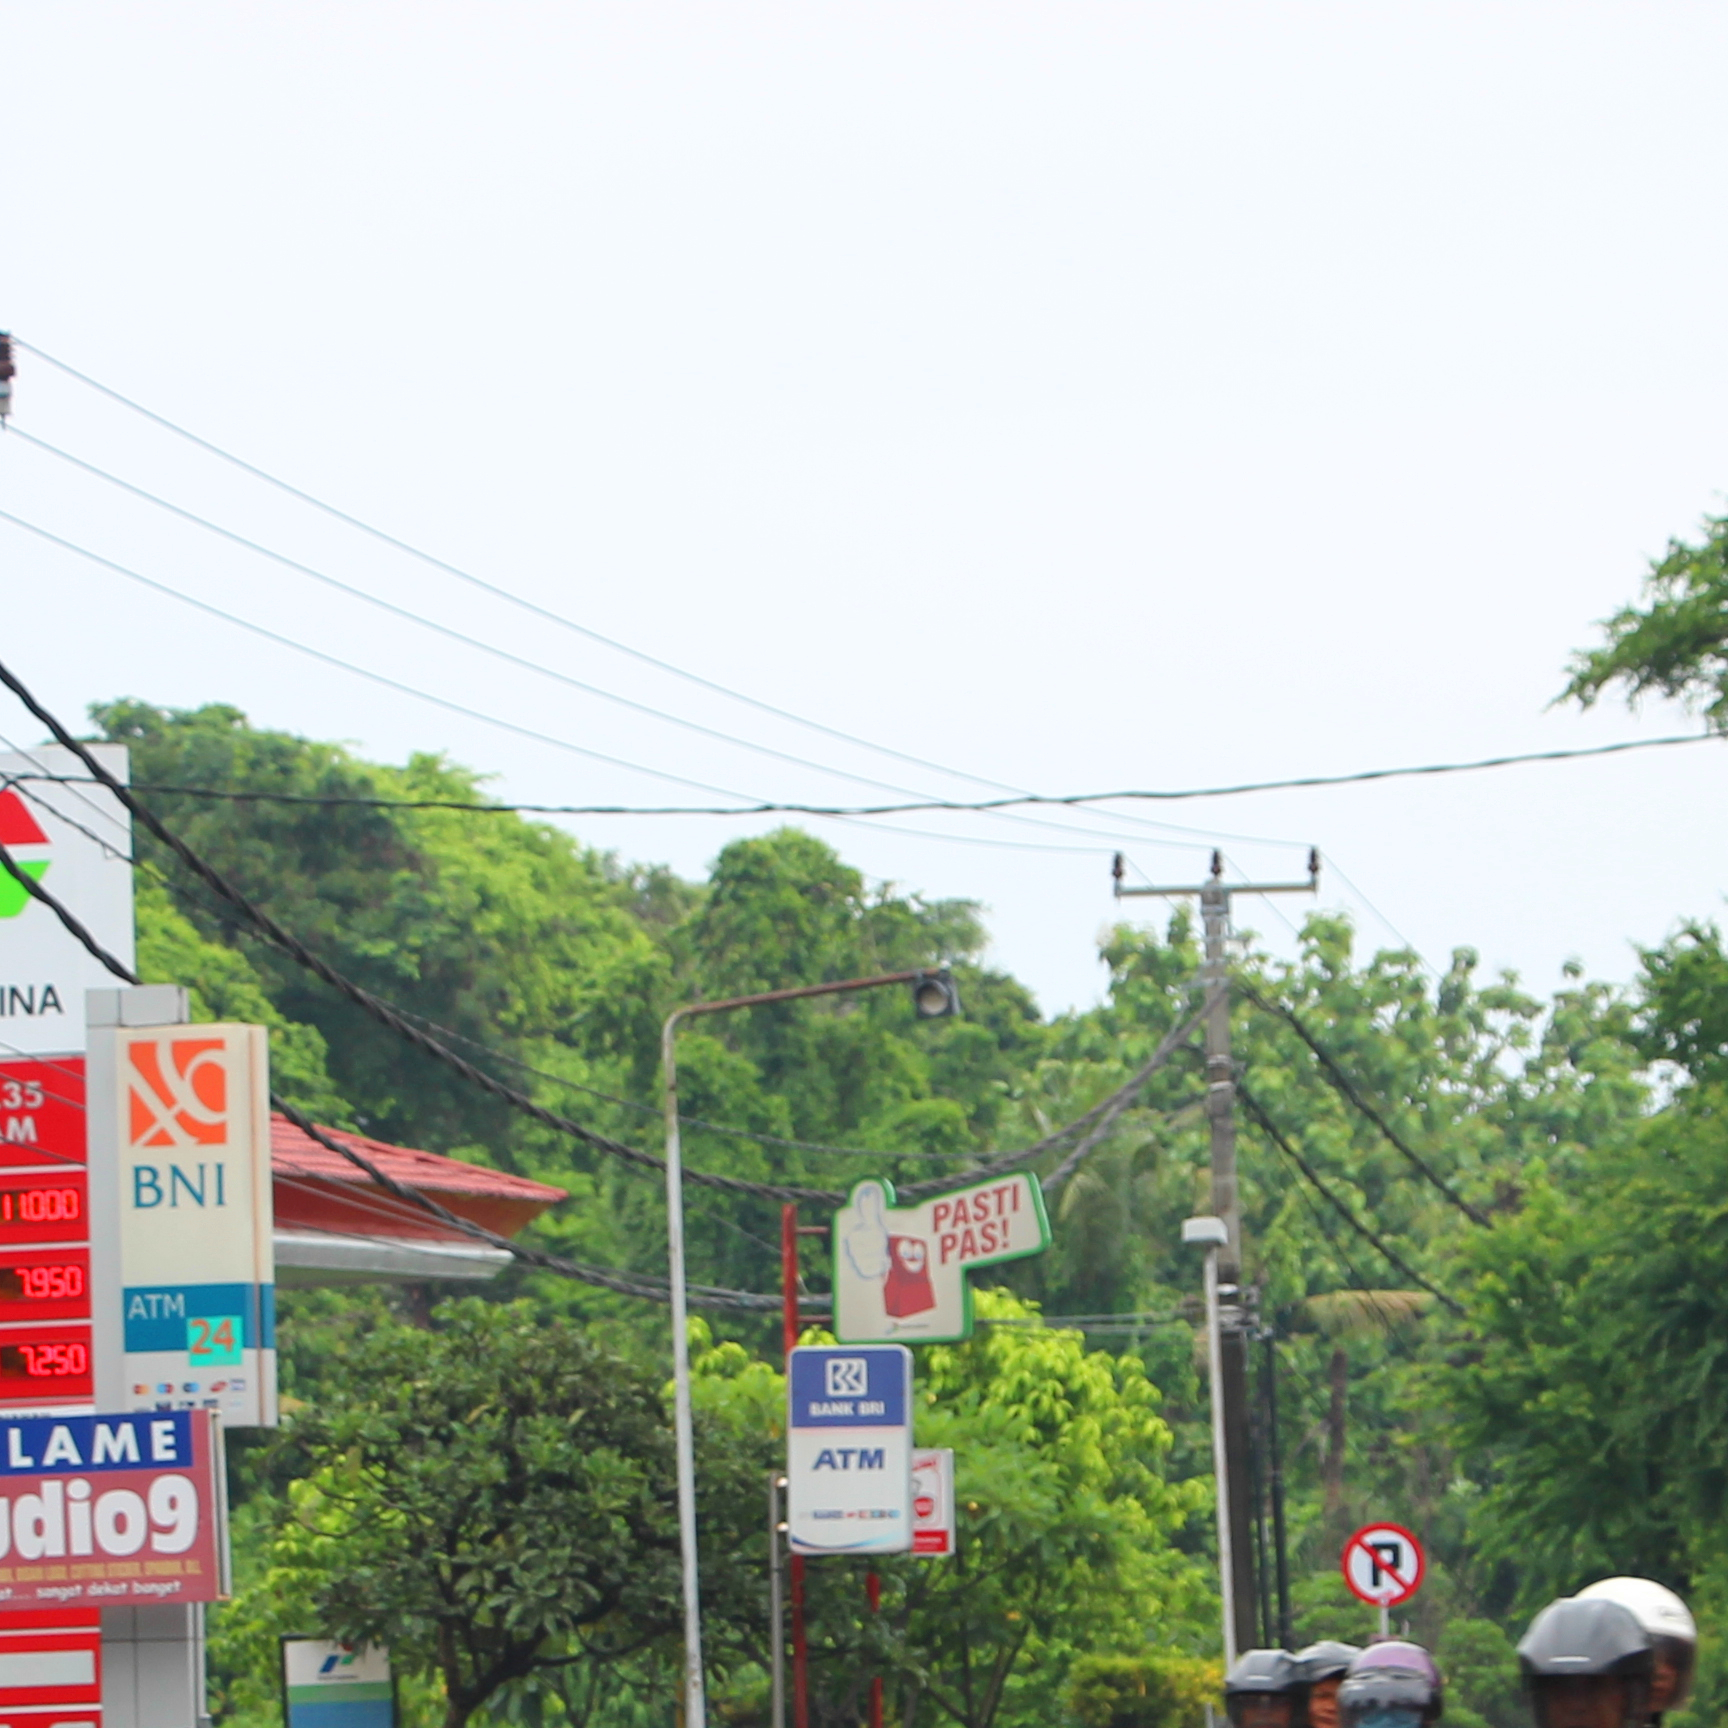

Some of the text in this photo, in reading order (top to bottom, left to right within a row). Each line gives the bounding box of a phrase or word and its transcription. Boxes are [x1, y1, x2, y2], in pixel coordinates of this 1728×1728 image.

[132, 1162, 226, 1208] BNI
[933, 1184, 1019, 1233] PASTI
[940, 1219, 1008, 1265] PAS!
[128, 1293, 185, 1320] ATM
[189, 1319, 235, 1355] 24
[809, 1401, 885, 1416] BANK BRI
[812, 1448, 886, 1471] ATM
